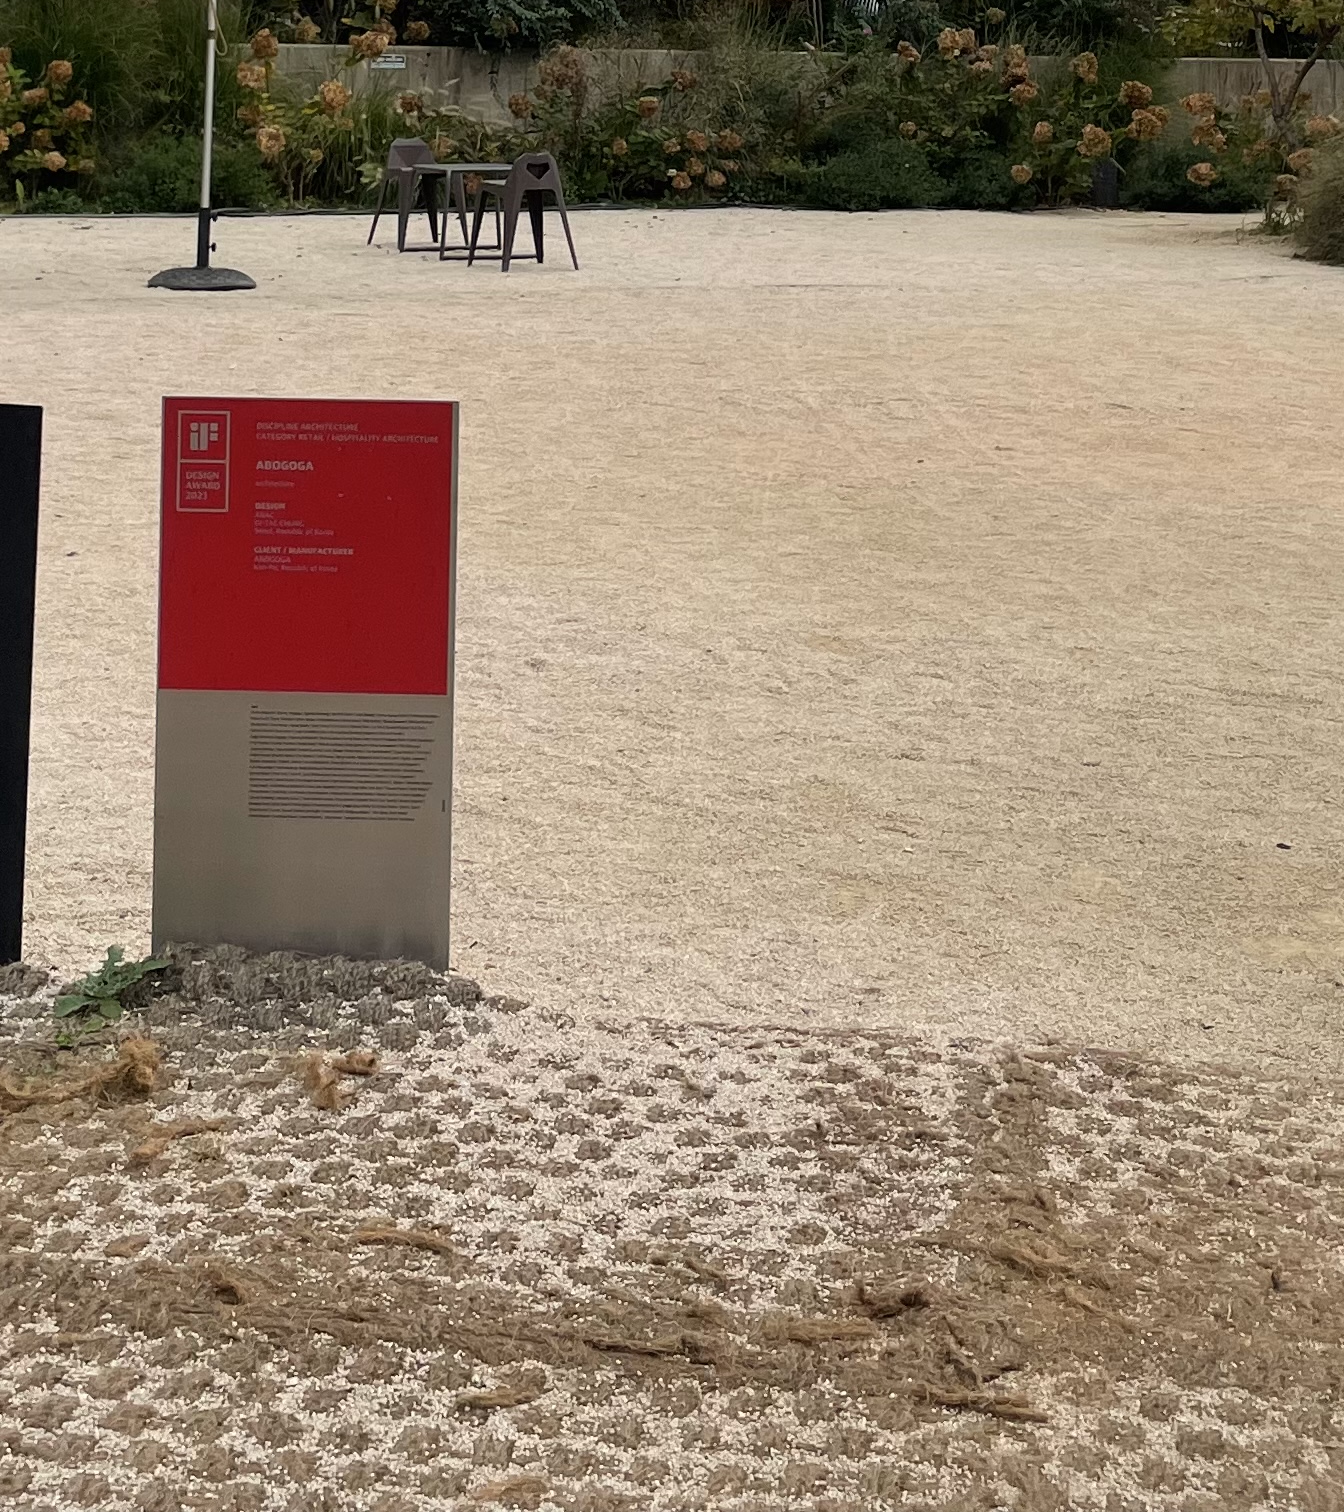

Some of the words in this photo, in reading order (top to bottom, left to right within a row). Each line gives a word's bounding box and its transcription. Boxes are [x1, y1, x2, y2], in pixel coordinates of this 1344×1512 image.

[256, 460, 314, 472] ABOGOGA
[186, 471, 220, 480] DESIGN
[186, 481, 221, 490] AWARD
